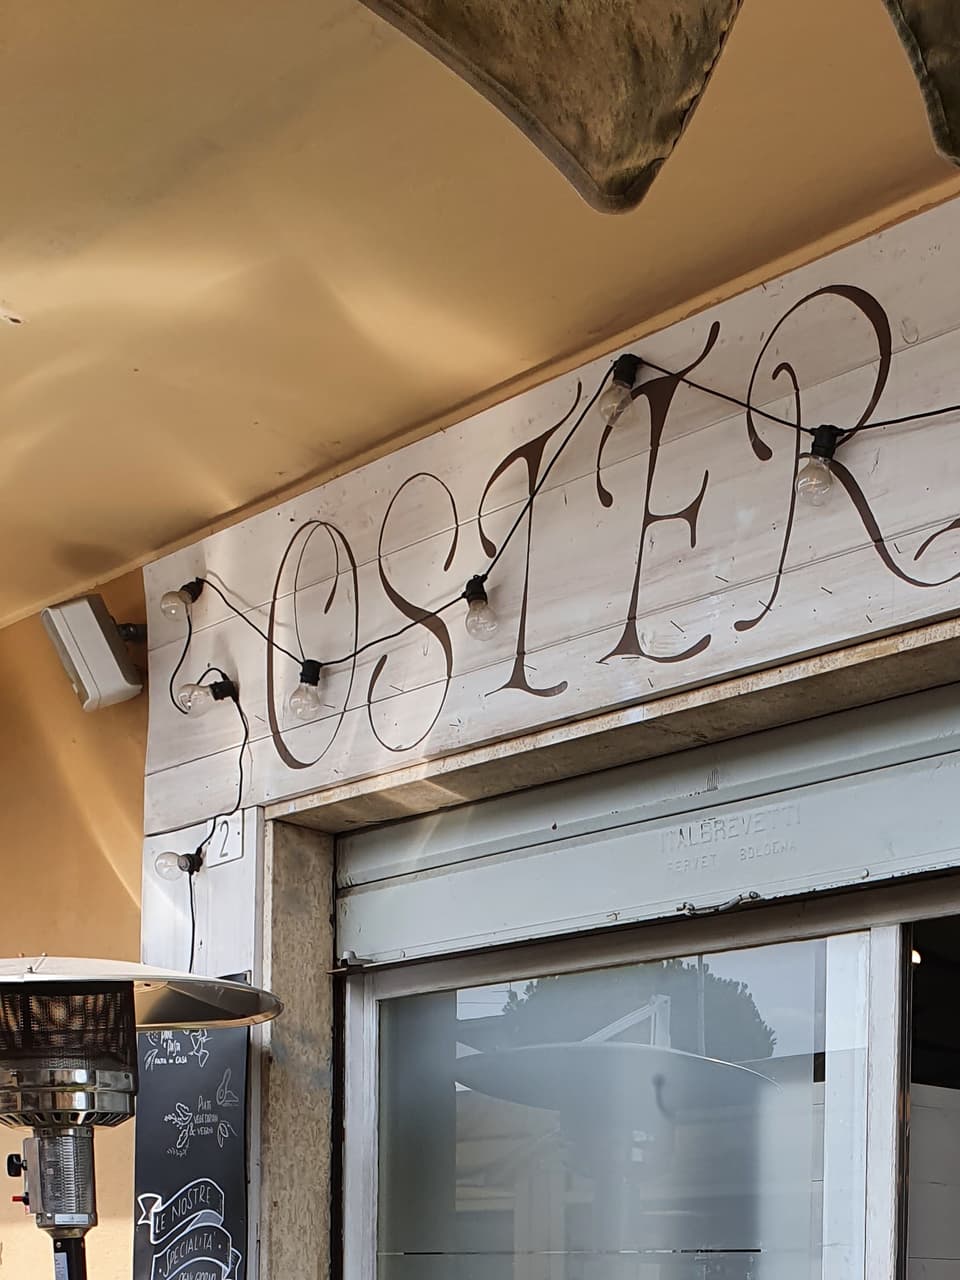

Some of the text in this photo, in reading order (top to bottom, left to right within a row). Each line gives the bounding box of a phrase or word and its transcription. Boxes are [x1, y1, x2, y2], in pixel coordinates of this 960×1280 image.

[219, 819, 229, 858] 2
[155, 1185, 212, 1233] LE NOSTRE
